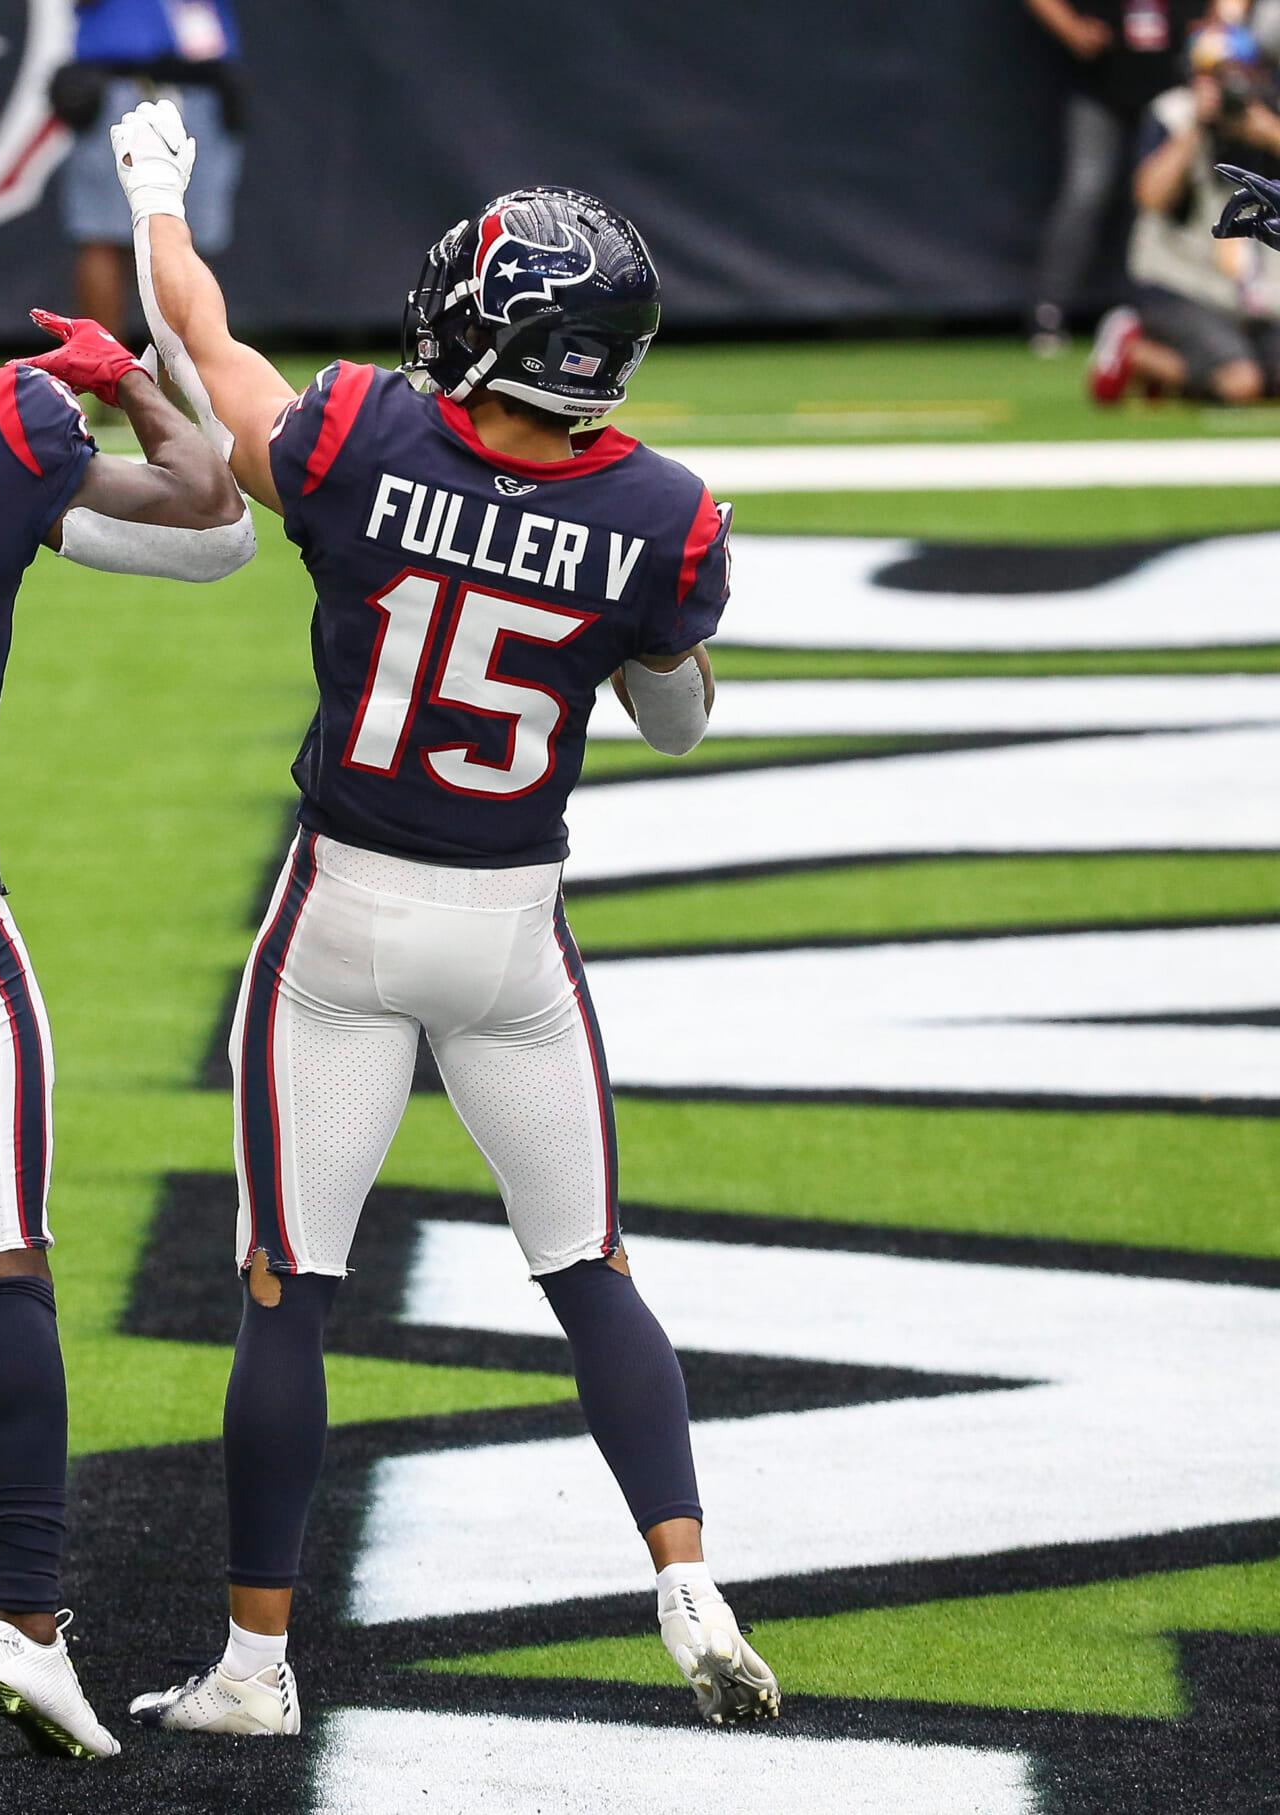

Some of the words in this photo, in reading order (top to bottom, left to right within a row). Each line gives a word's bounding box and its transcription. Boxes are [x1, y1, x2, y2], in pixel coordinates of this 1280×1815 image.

[365, 473, 590, 592] FULLER
[605, 531, 646, 601] V
[341, 565, 602, 801] 15
